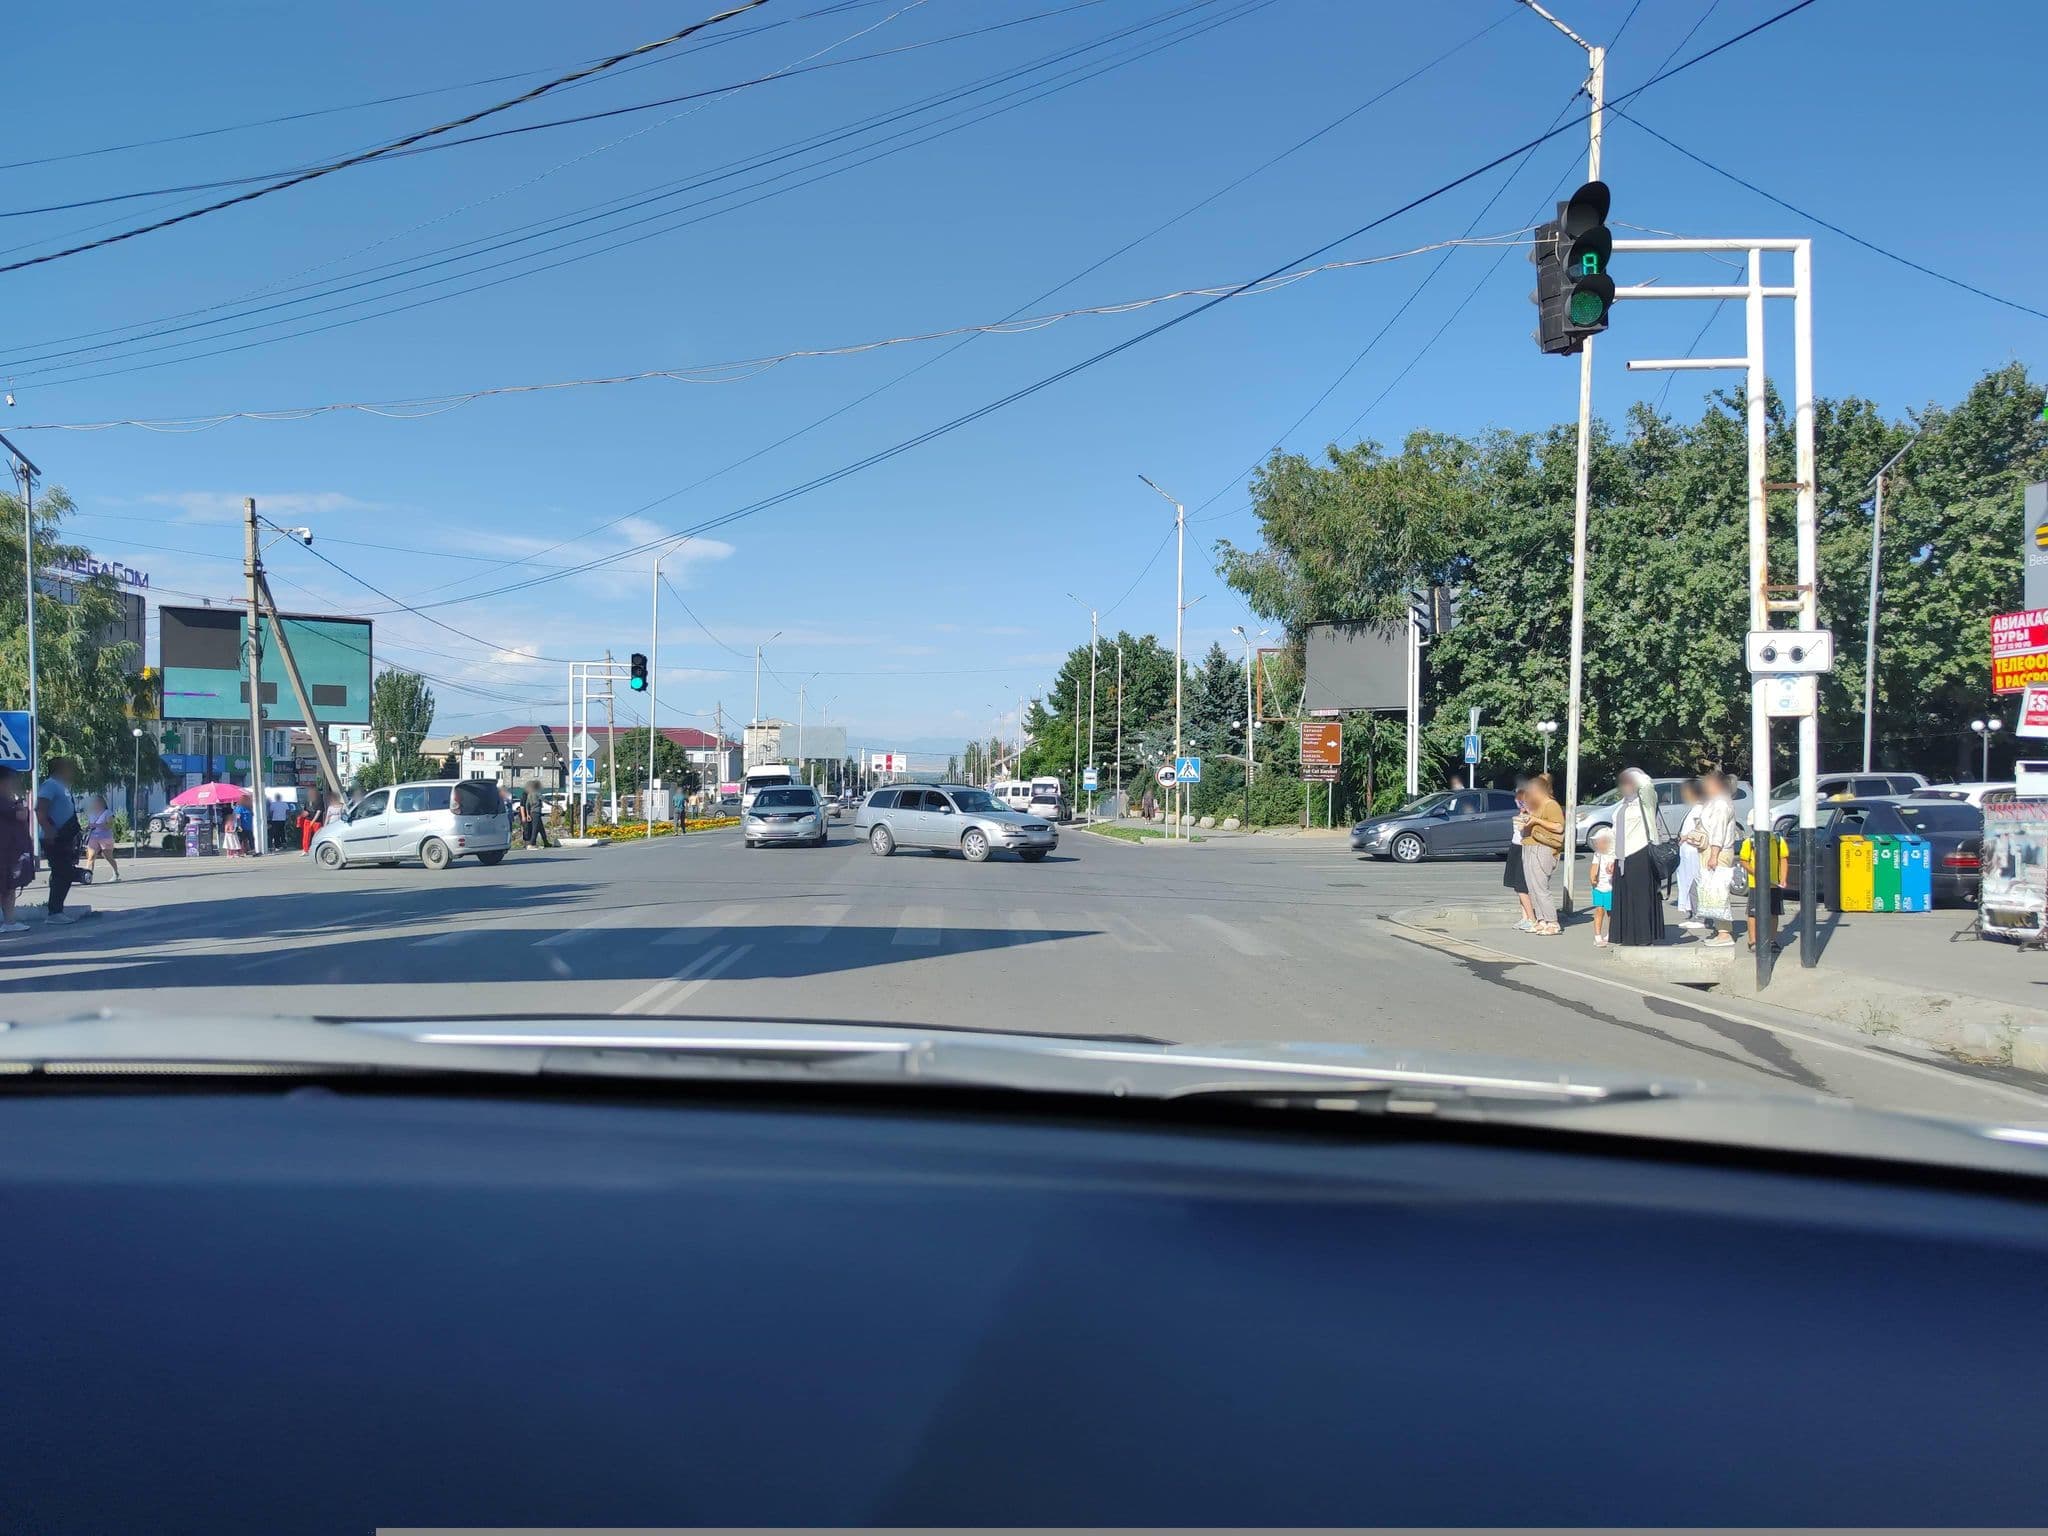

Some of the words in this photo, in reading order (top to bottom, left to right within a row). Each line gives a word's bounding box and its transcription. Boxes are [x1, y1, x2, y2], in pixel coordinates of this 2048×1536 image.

[1992, 628, 2030, 644] ТУРЫ
[1995, 653, 2048, 673] ТЕЛЕФО
[1995, 675, 2004, 689] В
[2028, 694, 2048, 712] ES
